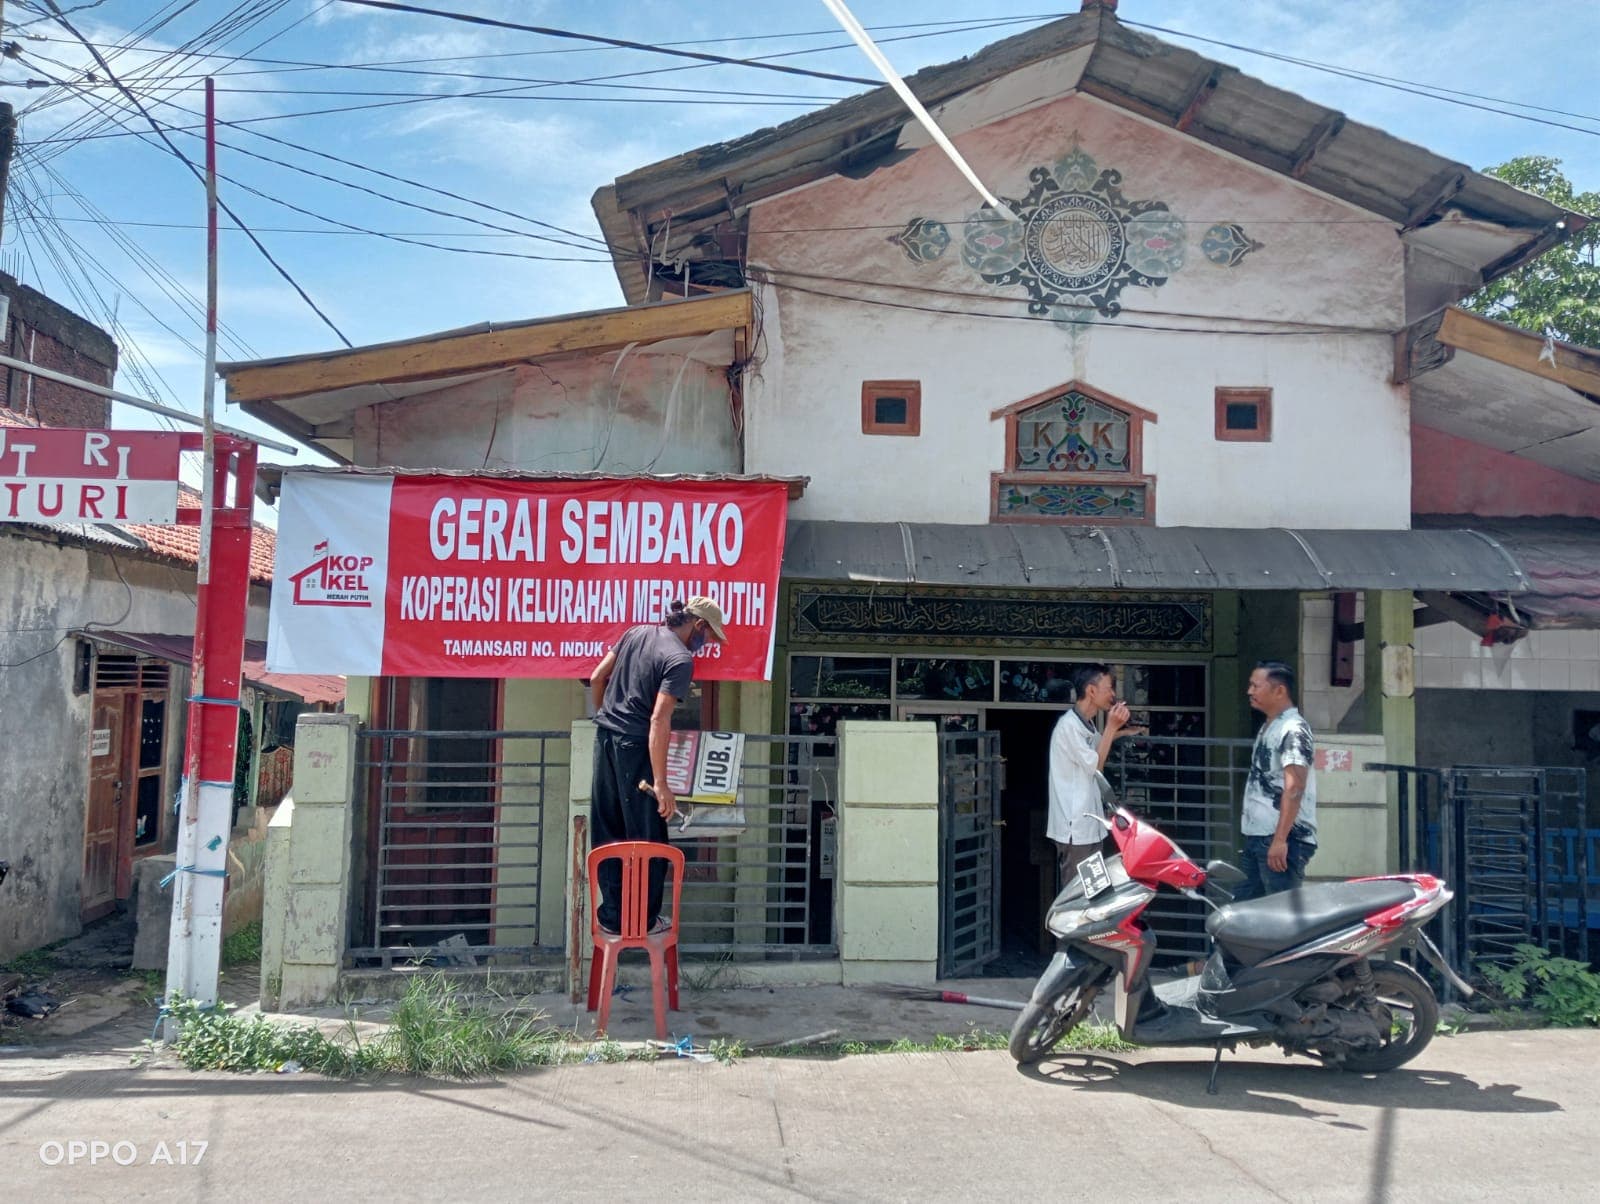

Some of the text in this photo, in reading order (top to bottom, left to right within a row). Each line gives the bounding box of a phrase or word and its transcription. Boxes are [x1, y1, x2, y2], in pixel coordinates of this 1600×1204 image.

[0, 428, 131, 480] T RI
[4, 483, 129, 520] TURI
[429, 497, 744, 566] GERAI SEMBAKO
[327, 575, 369, 590] KEL
[329, 555, 374, 571] KOP
[400, 576, 500, 622] KOPERASI
[507, 578, 627, 624] KELURAHAN
[443, 640, 527, 657] TAMANSARI
[532, 641, 555, 657] NO.
[560, 641, 604, 657] INDUK
[704, 746, 731, 788] HUB.
